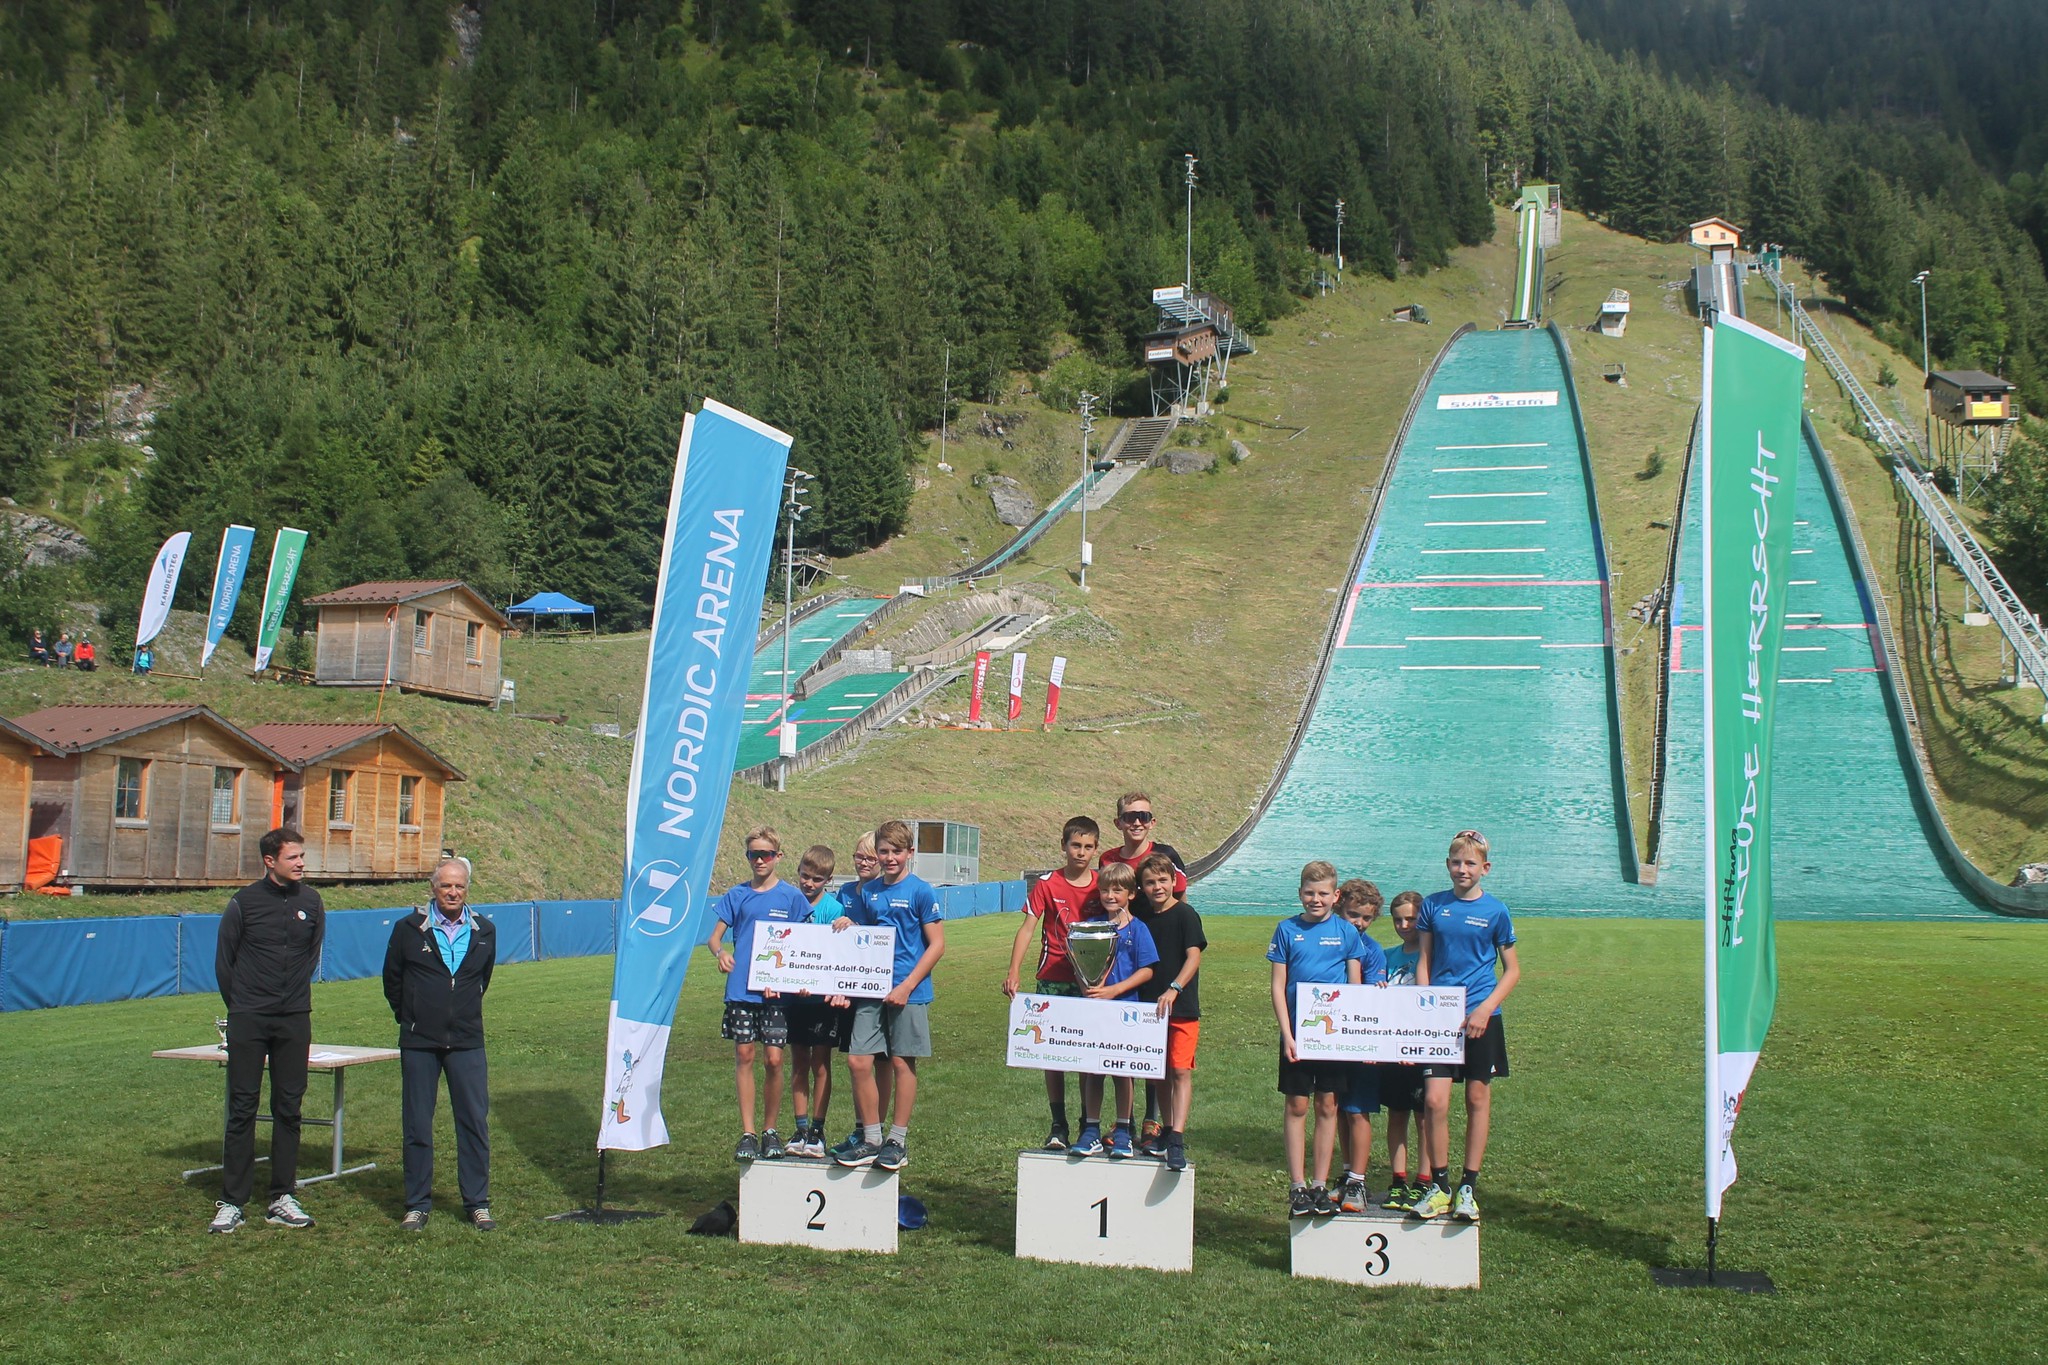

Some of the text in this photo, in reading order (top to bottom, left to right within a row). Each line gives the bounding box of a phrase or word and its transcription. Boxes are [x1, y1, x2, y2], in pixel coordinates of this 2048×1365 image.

[1450, 398, 1544, 408] swisscom
[220, 544, 243, 611] NORDIC ARENA
[279, 547, 298, 597] HERRSCHT
[160, 552, 179, 607] KANDERSTEG
[657, 507, 745, 840] NORDIC ARENA
[1732, 429, 1780, 949] FREUDE HERRSCHT
[790, 950, 822, 960] 2. Rang
[788, 961, 892, 975] Bundesrat-Adolf-Ogi-Cup
[782, 977, 820, 987] HERRSCHT
[837, 980, 885, 991] CHF 400.-
[1341, 1014, 1379, 1025] 3. Rang
[1060, 1026, 1084, 1036] Rang
[1341, 1027, 1464, 1039] Bundesrat-Adolf-Ogi-Cup
[1048, 1037, 1164, 1055] Bundesrat-Adolf-Ogi-Cup
[1303, 1043, 1379, 1053] FREUDE HERRSCHT
[1400, 1046, 1458, 1057] CHF 200.-
[1043, 1053, 1083, 1064] HERRSCHT
[1103, 1059, 1158, 1072] CHF 600.-
[806, 1189, 827, 1232] 2
[1090, 1196, 1110, 1239] 1
[1363, 1232, 1391, 1277] 3
